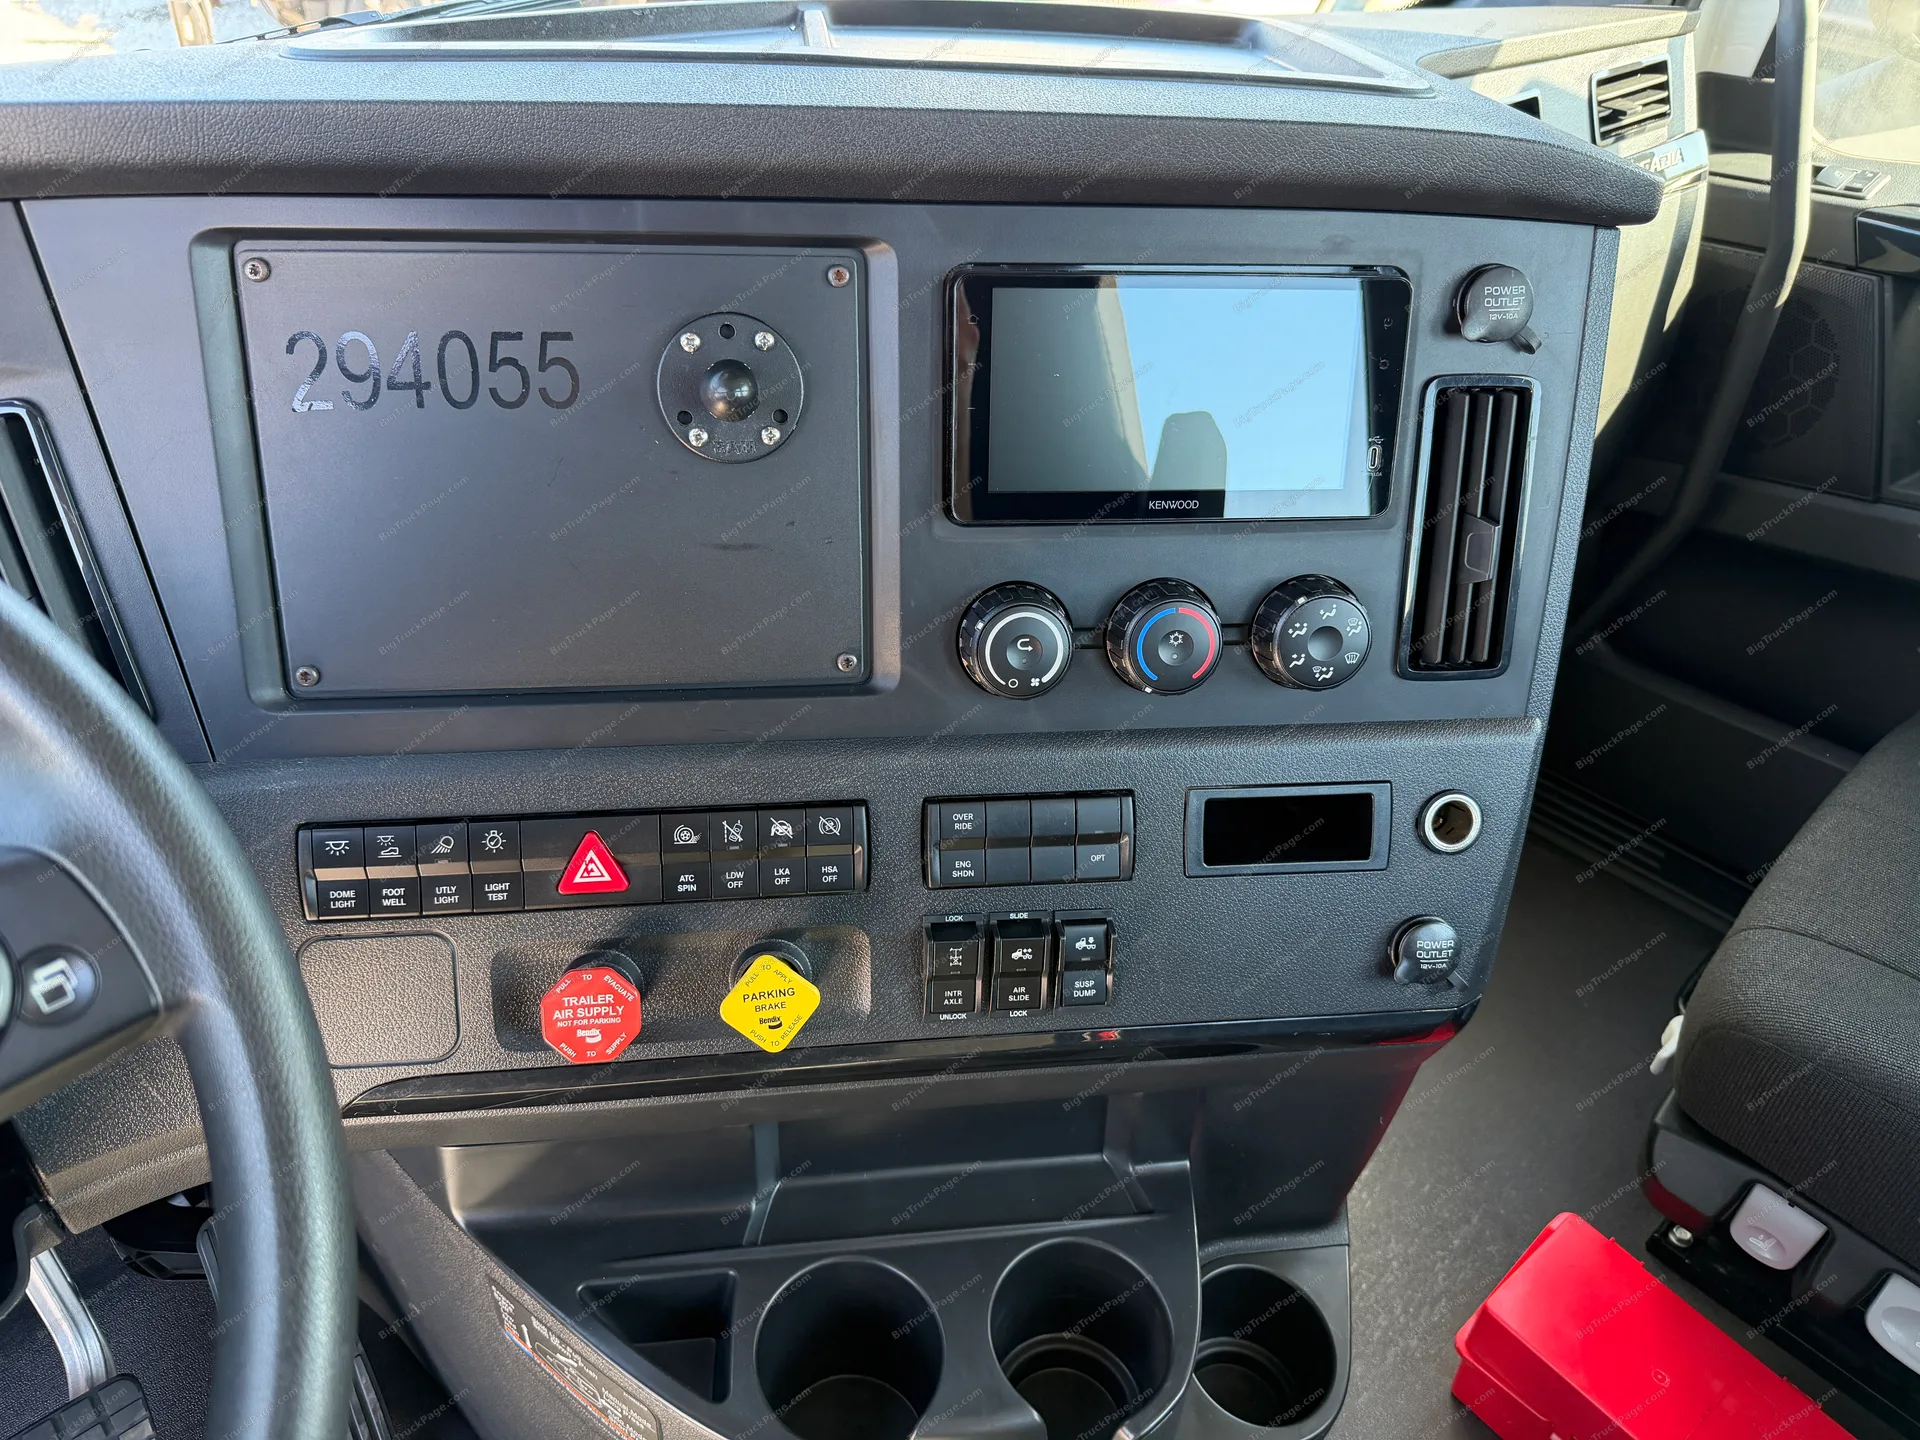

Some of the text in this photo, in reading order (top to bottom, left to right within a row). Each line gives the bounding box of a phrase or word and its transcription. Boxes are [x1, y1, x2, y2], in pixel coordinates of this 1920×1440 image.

[1485, 286, 1525, 295] POWER
[1485, 297, 1525, 306] OUTLET
[286, 330, 581, 412] 294055
[1148, 500, 1200, 510] KENWOOD
[952, 813, 973, 821] OVER
[1090, 854, 1106, 862] OPT
[774, 868, 790, 876] LKA
[821, 866, 838, 874] HSA
[679, 874, 695, 883] ATC
[726, 871, 744, 880] LDW
[822, 874, 838, 883] OFF
[727, 880, 744, 889] OFF
[774, 876, 790, 885] OFF
[382, 888, 405, 896] FOOT
[435, 886, 457, 895] UTLY
[485, 883, 510, 892] LIGHT
[677, 883, 697, 892] SPIN
[330, 890, 356, 898] DOME
[487, 893, 508, 901] TEST
[330, 900, 356, 908] LIGHT
[382, 897, 406, 906] WELL
[434, 895, 459, 904] LIGHT
[1417, 940, 1454, 949] POWER
[1416, 950, 1453, 958] OUTLET
[745, 973, 759, 987] PULL
[773, 969, 793, 984] APPLY
[555, 978, 572, 993] PULL
[603, 975, 635, 1002] EVACUATE
[1074, 980, 1094, 988] SUSP
[1012, 986, 1026, 994] AIR
[1073, 989, 1096, 997] DUMP
[743, 987, 796, 1003] PARKING
[562, 994, 614, 1006] TRAILER
[755, 1002, 786, 1012] BRAKE
[553, 1006, 625, 1020] AIR SUPPLY
[759, 1016, 781, 1025] Bendix
[577, 1028, 601, 1037] Bendix
[750, 1030, 767, 1043] PUSH
[781, 1014, 803, 1040] RELEASE
[560, 1042, 577, 1058] PUSH
[606, 1032, 627, 1055] SUPPLY
